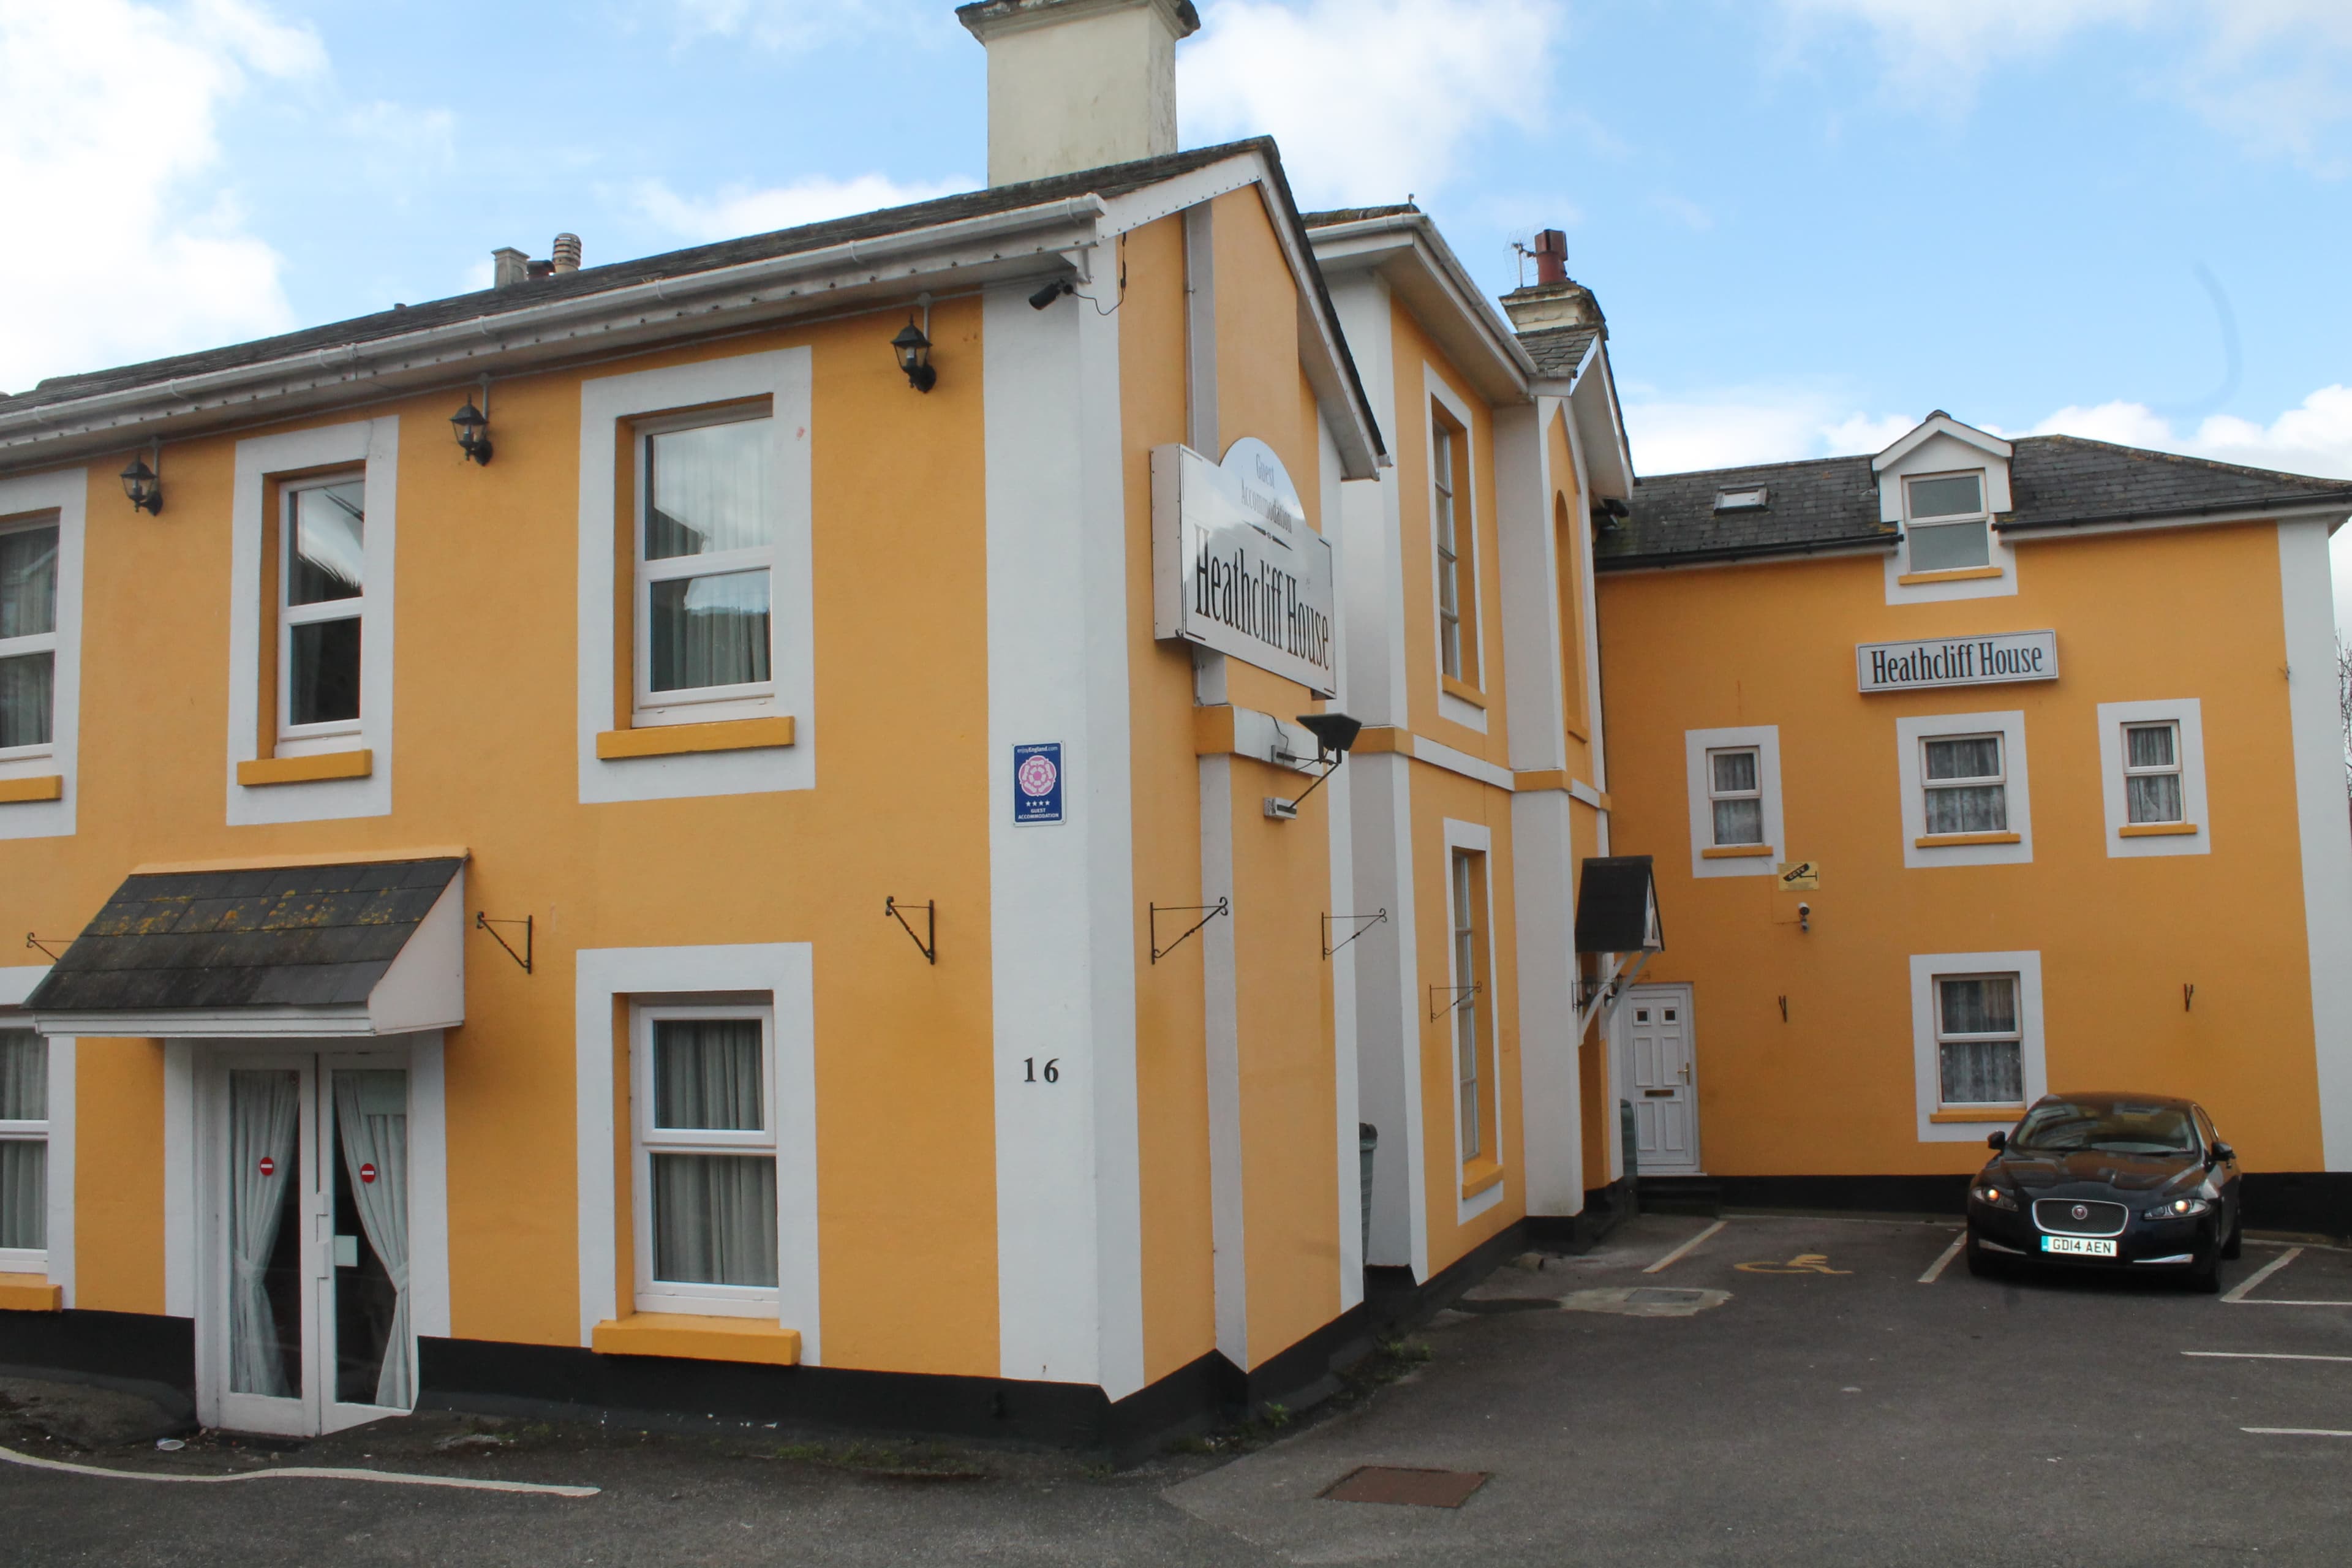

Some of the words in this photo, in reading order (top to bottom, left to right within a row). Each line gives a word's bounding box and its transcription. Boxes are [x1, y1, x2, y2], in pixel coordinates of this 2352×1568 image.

[1256, 453, 1275, 489] Guest
[1241, 476, 1292, 534] Accommodation
[1194, 524, 1283, 649] Heathcliff
[1285, 573, 1330, 671] House
[1871, 644, 1974, 684] Heathcliff
[1978, 642, 2043, 676] House
[1789, 867, 1805, 879] CCTV
[1024, 1057, 1060, 1083] 16
[2052, 1238, 2081, 1251] GD14
[2086, 1241, 2111, 1254] AEN
